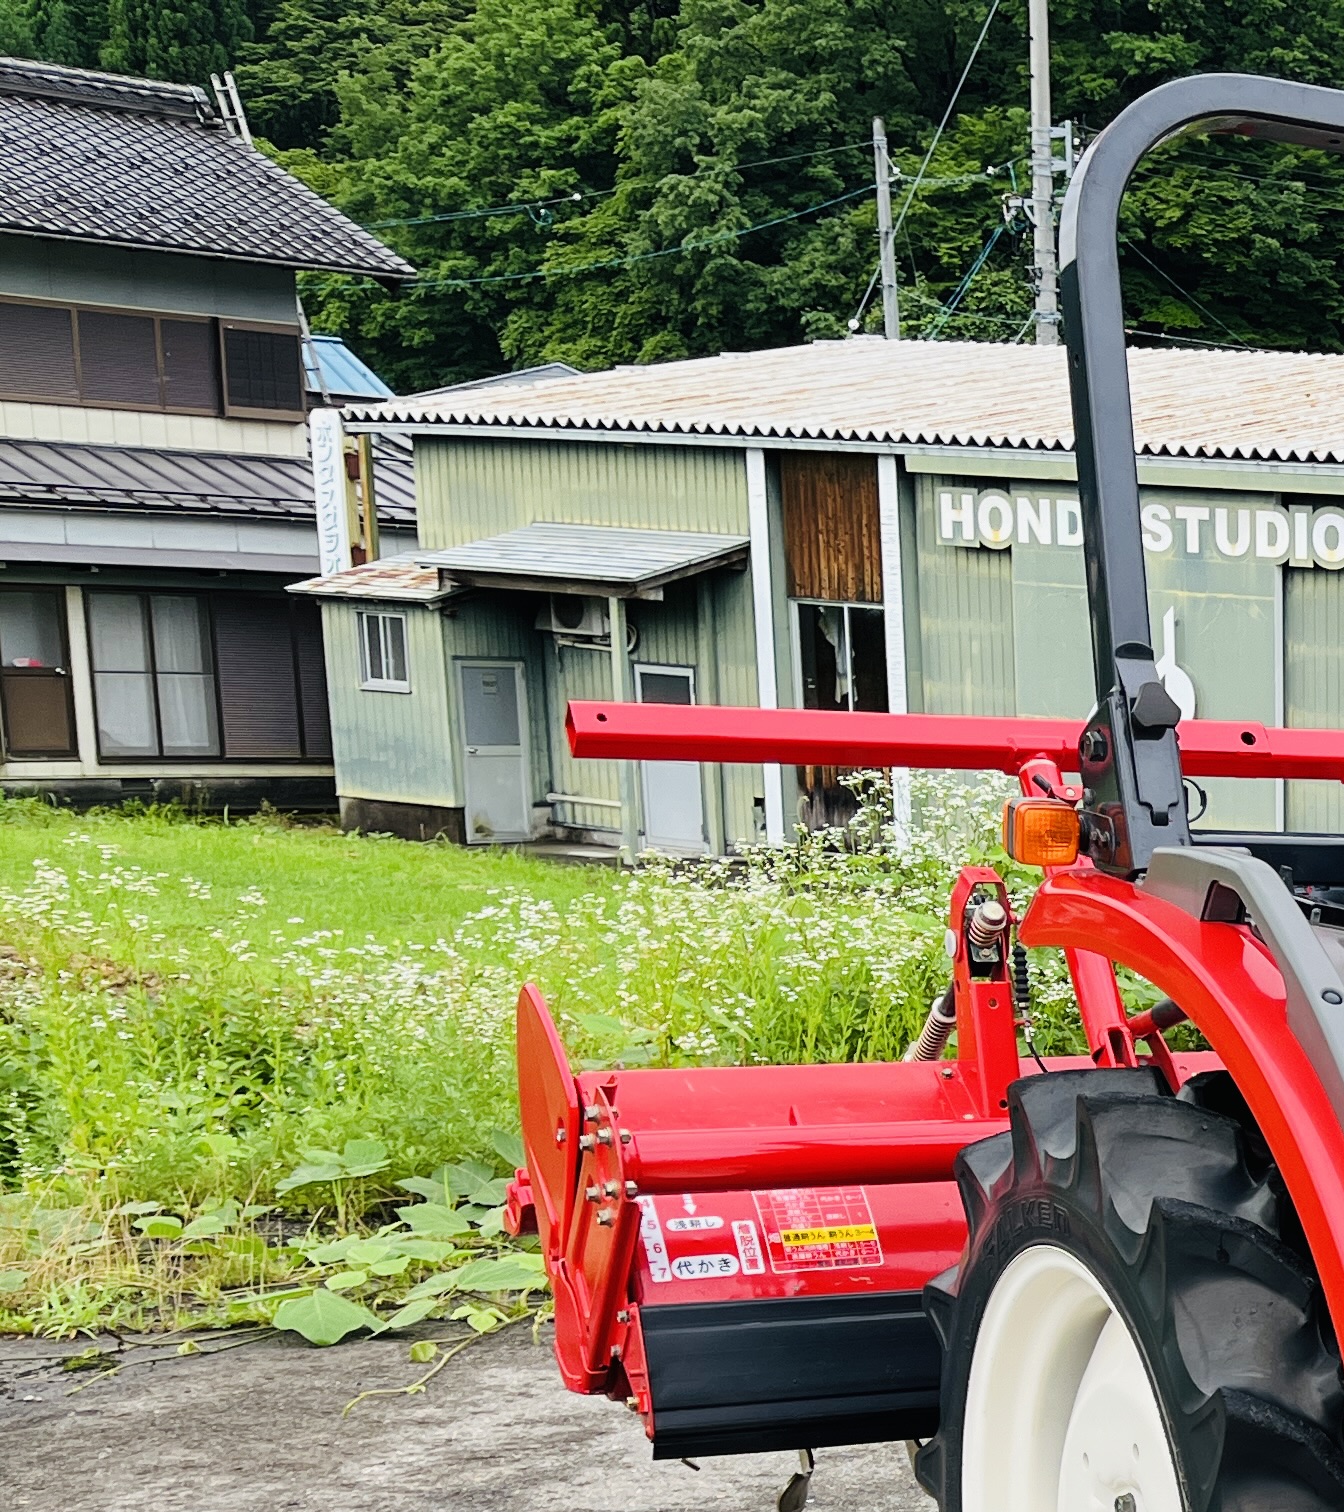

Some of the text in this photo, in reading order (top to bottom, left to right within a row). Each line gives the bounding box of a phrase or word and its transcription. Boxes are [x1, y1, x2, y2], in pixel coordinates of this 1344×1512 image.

[938, 491, 1084, 548] HOND
[646, 1219, 657, 1230] 5
[652, 1242, 663, 1254] 6
[675, 1257, 732, 1276] 代かき
[657, 1267, 668, 1279] 7
